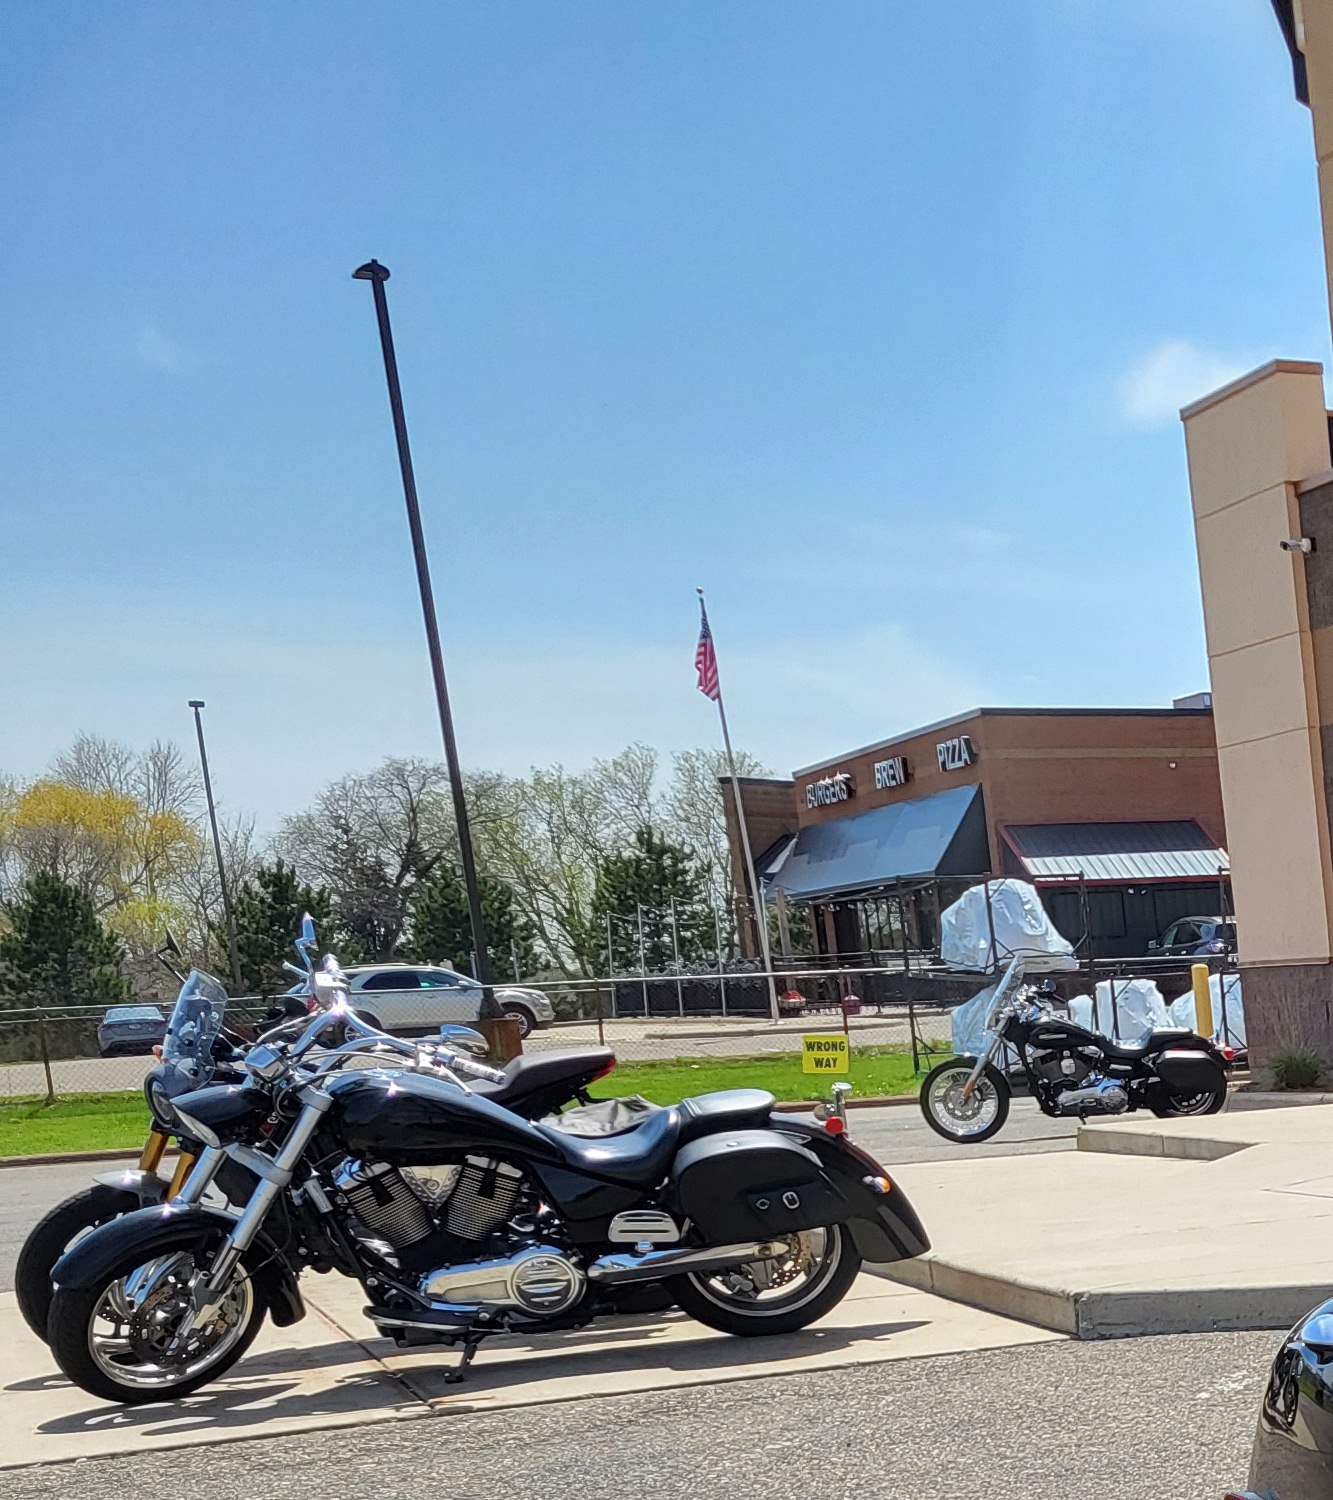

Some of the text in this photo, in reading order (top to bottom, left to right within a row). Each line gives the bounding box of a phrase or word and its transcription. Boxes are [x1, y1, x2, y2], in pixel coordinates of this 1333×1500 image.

[805, 735, 972, 809] BURGERS BREW PIZZA
[805, 1040, 846, 1052] WRONG
[812, 1056, 838, 1069] WAY
